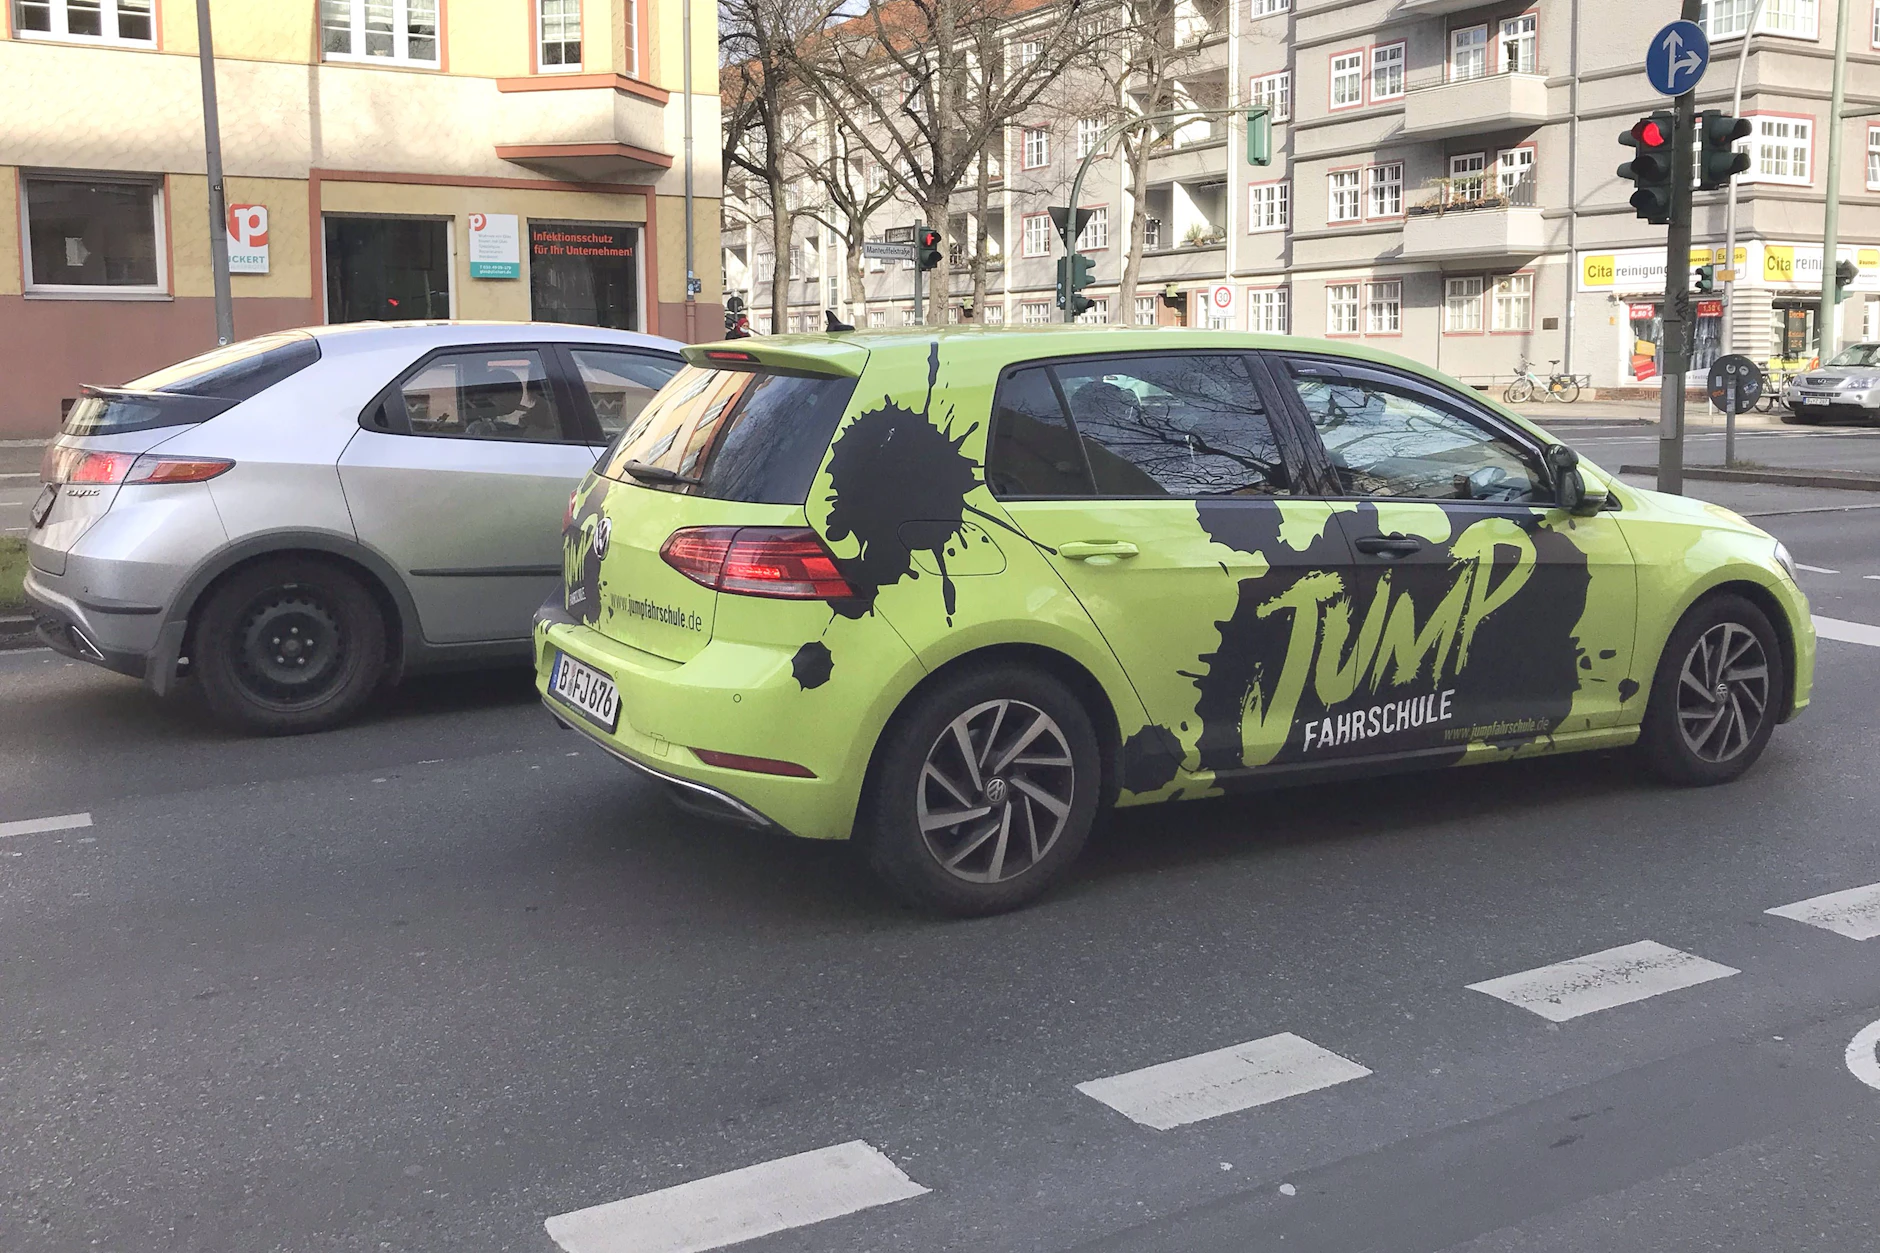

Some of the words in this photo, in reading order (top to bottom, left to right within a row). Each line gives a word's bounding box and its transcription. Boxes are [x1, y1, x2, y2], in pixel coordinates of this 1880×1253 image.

[533, 231, 613, 244] Infektionsschutz
[534, 244, 548, 254] für
[550, 245, 564, 255] Ihr
[566, 246, 633, 256] Unternehmen!
[1587, 265, 1613, 278] Cita
[1767, 255, 1791, 271] Cita
[1795, 256, 1823, 270] reini
[1218, 292, 1228, 302] 30
[610, 593, 702, 632] www.jumpfahrschule.de
[1240, 516, 1537, 767] JUMP
[560, 660, 570, 691] B
[1303, 689, 1455, 752] FAHRSCHULE
[1444, 716, 1549, 740] www.jumpfahrschule.de
